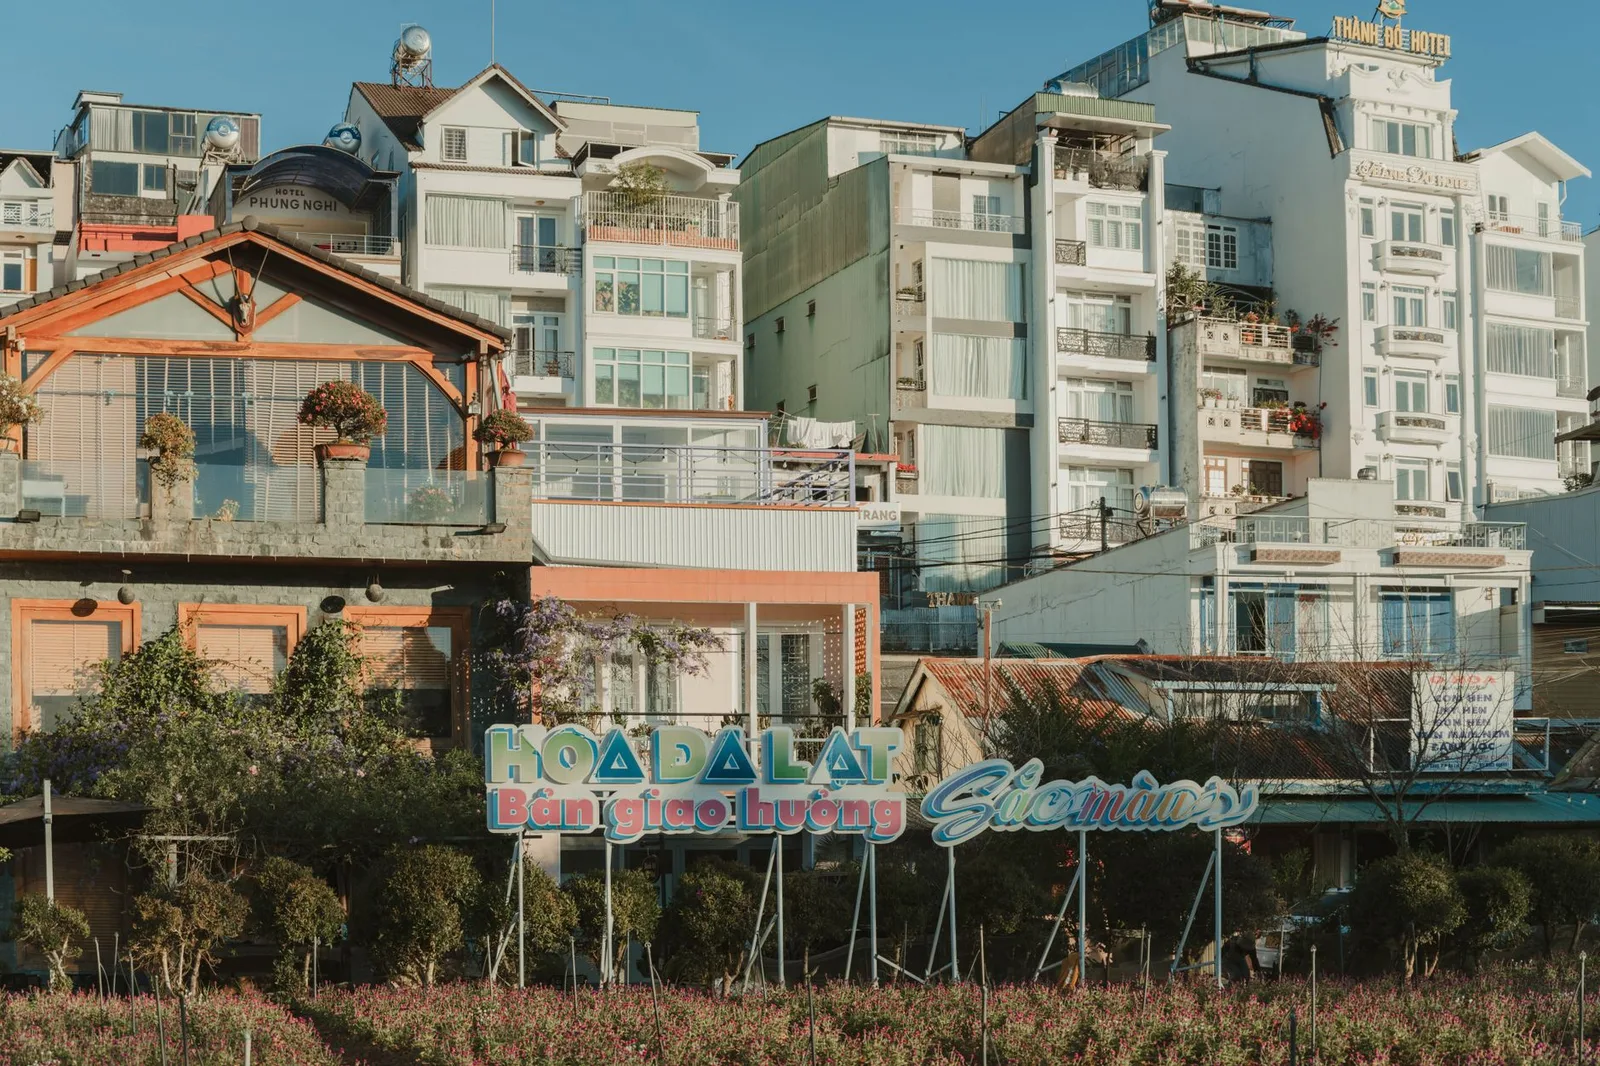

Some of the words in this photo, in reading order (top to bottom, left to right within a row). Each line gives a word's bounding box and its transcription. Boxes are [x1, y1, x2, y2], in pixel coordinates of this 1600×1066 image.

[1410, 29, 1451, 56] HOTEL
[250, 197, 300, 210] PHUNG
[303, 199, 337, 211] NGHI
[275, 188, 305, 196] HOTEL
[487, 727, 646, 785] HOA
[491, 787, 595, 831] Bản
[608, 788, 727, 838] giao
[742, 787, 902, 838] hưởng
